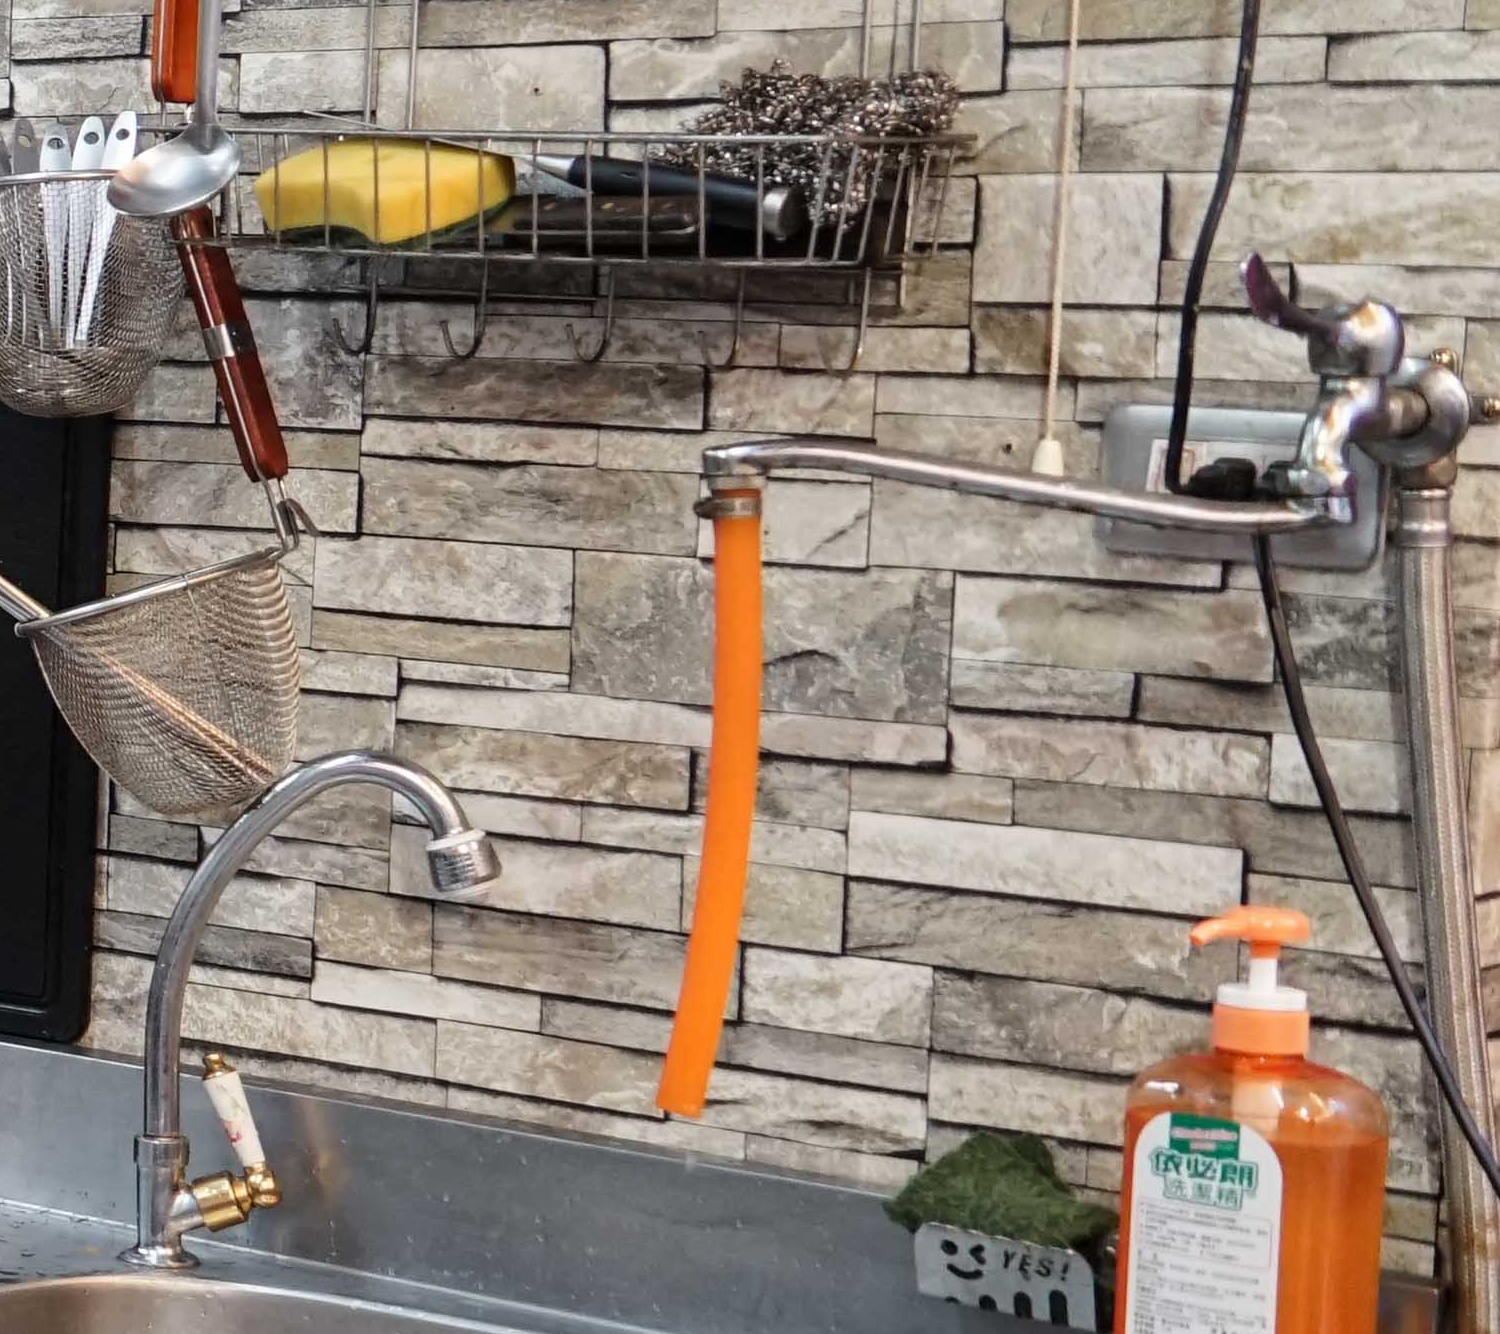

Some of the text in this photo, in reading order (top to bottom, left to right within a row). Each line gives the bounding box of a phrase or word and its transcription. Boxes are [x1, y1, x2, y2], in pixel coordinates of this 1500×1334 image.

[1152, 1148, 1258, 1192] 依必朗
[1002, 1247, 1070, 1283] YES!
